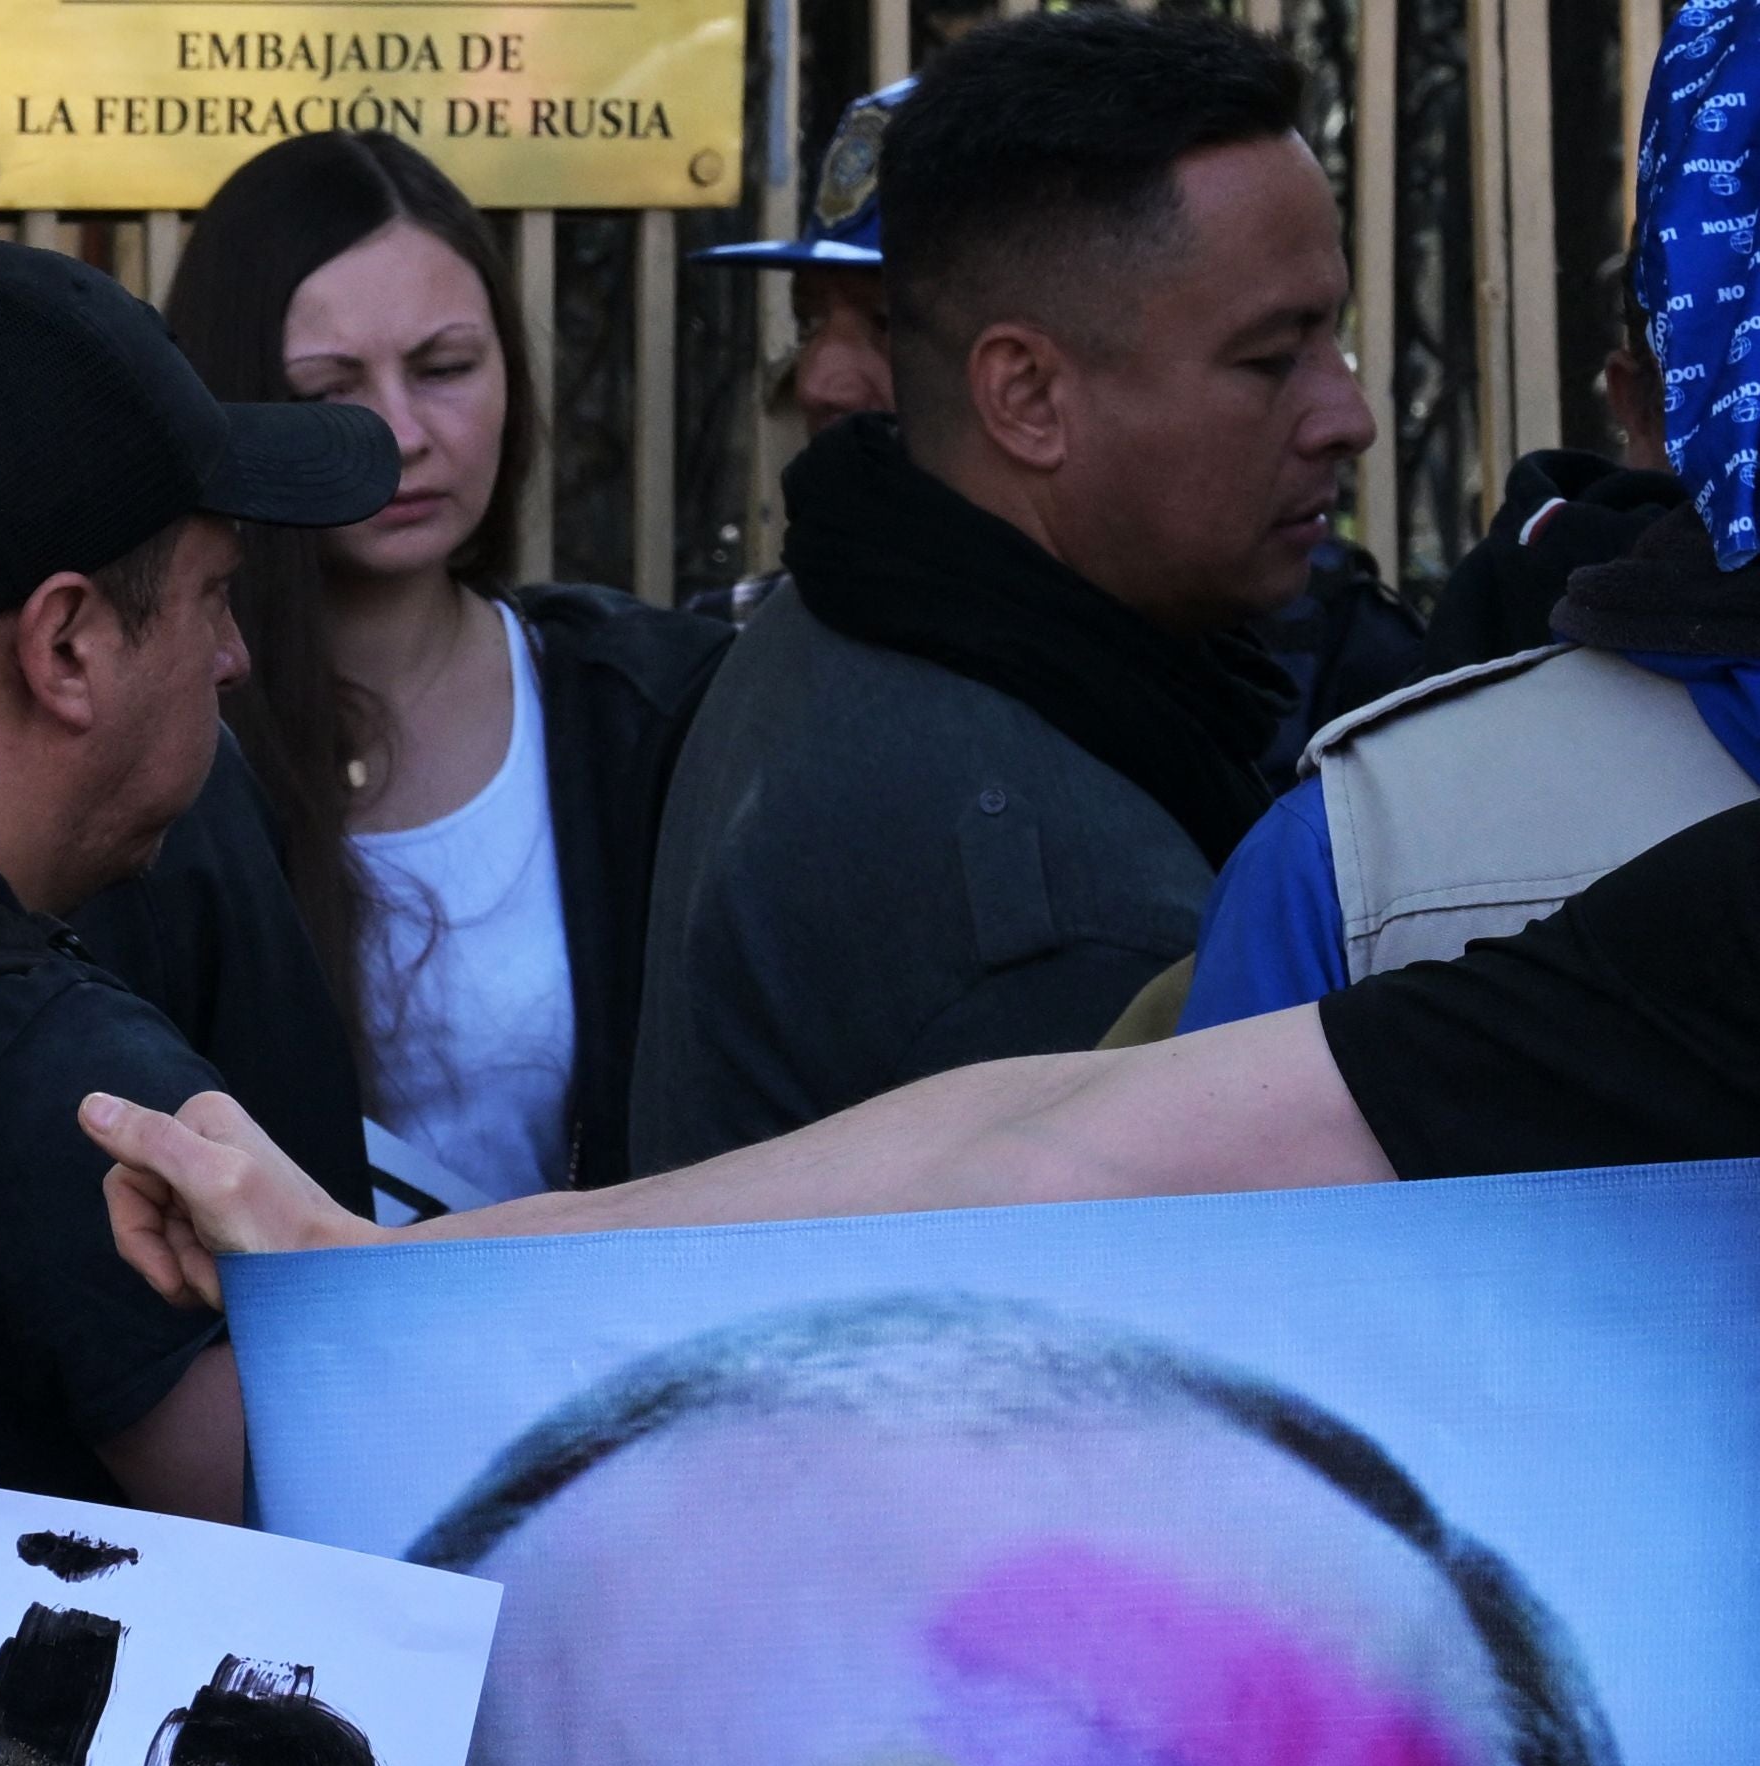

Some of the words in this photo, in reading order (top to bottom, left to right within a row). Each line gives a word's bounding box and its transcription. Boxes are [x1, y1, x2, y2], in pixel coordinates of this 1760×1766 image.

[176, 31, 446, 82] EMBAJADA
[457, 33, 525, 75] DE
[16, 96, 76, 135] LA
[94, 85, 423, 138] FEDERACIÓN
[446, 97, 509, 138] DE
[529, 98, 673, 141] RUSIA
